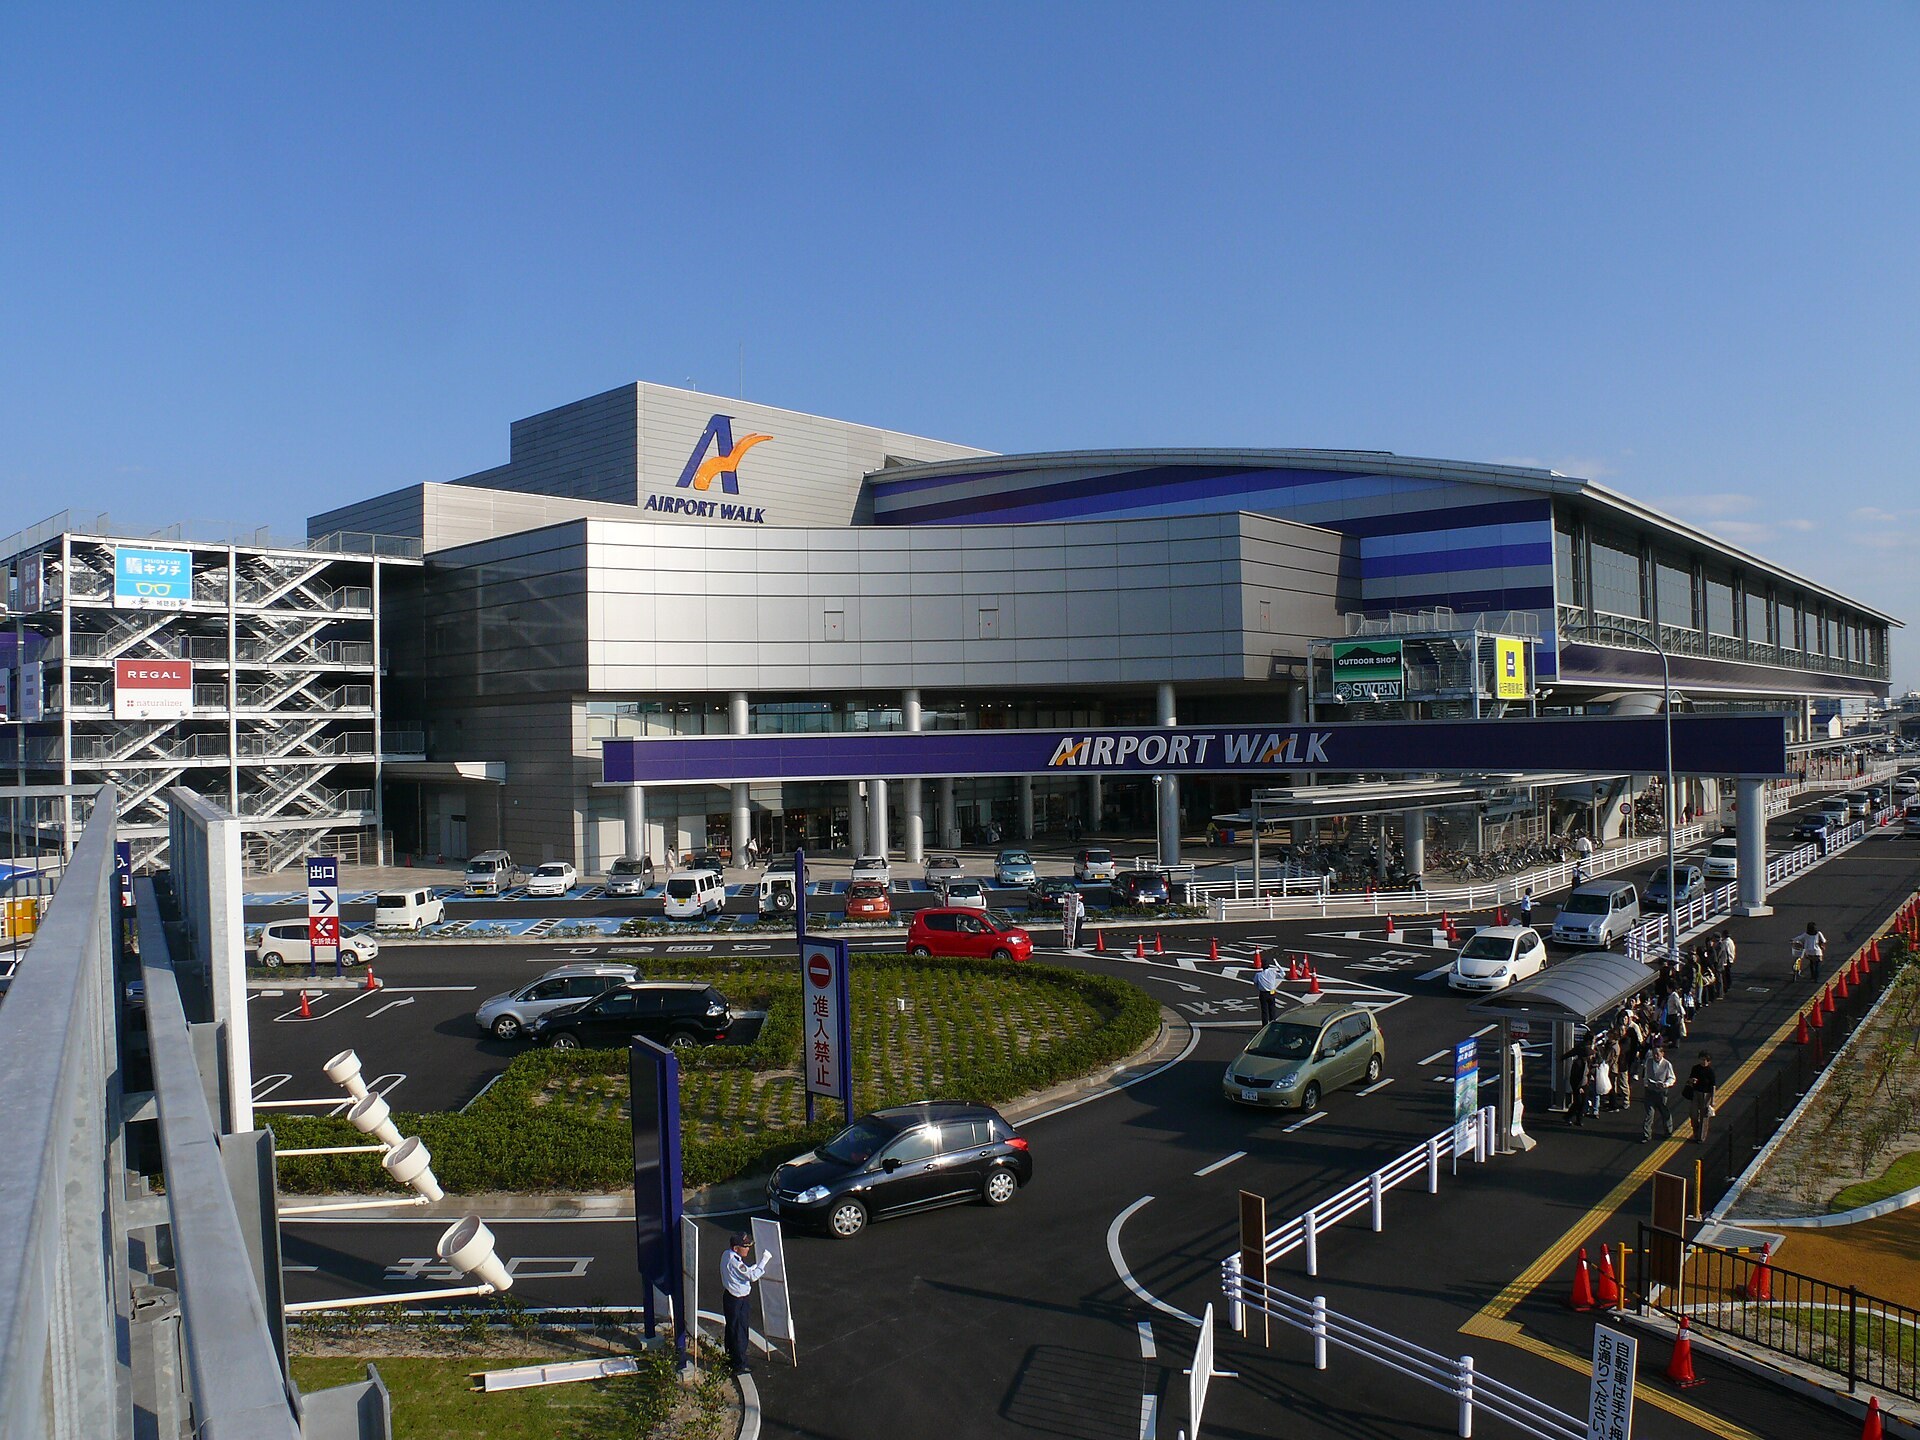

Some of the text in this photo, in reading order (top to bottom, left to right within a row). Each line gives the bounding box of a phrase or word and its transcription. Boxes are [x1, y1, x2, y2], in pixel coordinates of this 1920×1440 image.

[643, 494, 767, 524] AIRPORT WALK
[143, 563, 182, 577] キクチ
[1338, 656, 1397, 666] OUTDOOR SHOP
[127, 670, 182, 679] REGAL
[1352, 681, 1401, 698] SWEN
[136, 699, 184, 708] naturalizer
[1047, 732, 1334, 766] AIRPORT WALK
[310, 865, 335, 880] 出口
[311, 937, 338, 945] 左折禁止
[812, 994, 832, 1088] 進入禁止
